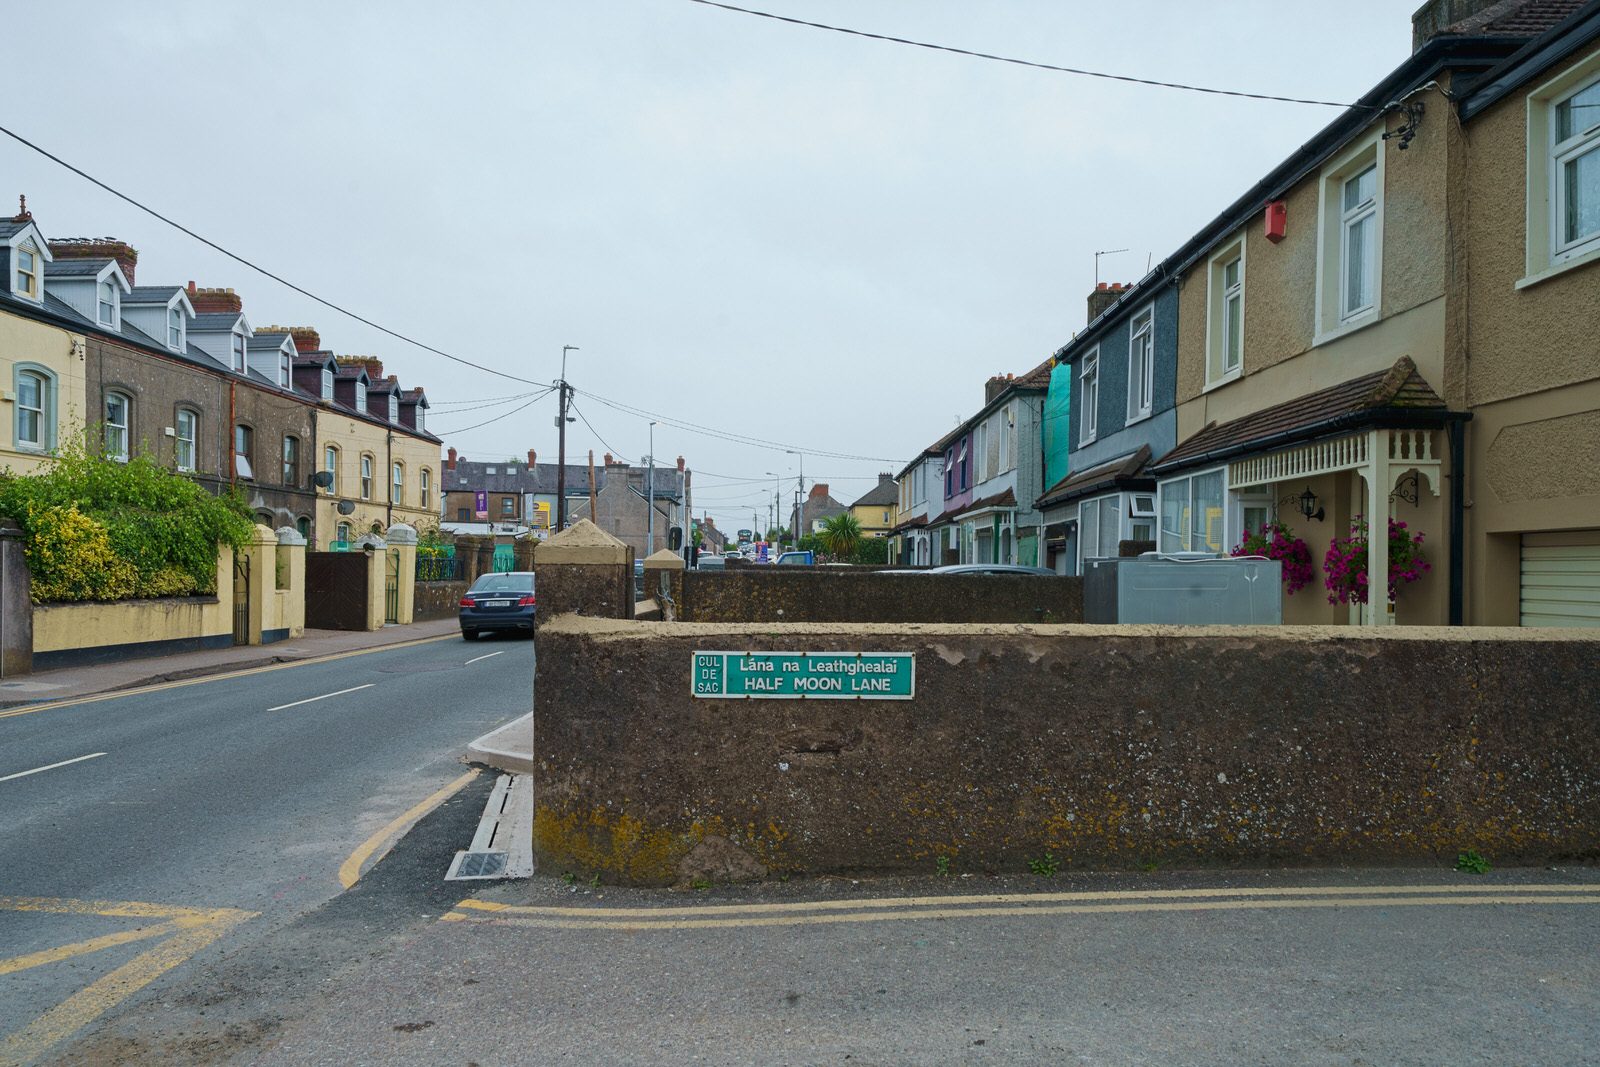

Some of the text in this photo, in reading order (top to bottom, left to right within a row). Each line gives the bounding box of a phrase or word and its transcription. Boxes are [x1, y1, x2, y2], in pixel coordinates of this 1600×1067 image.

[698, 656, 720, 667] CUL
[740, 657, 774, 672] Lána
[782, 661, 800, 672] na
[702, 669, 717, 680] DE
[697, 682, 719, 693] SAC
[744, 677, 891, 691] HALF MOON LANE
